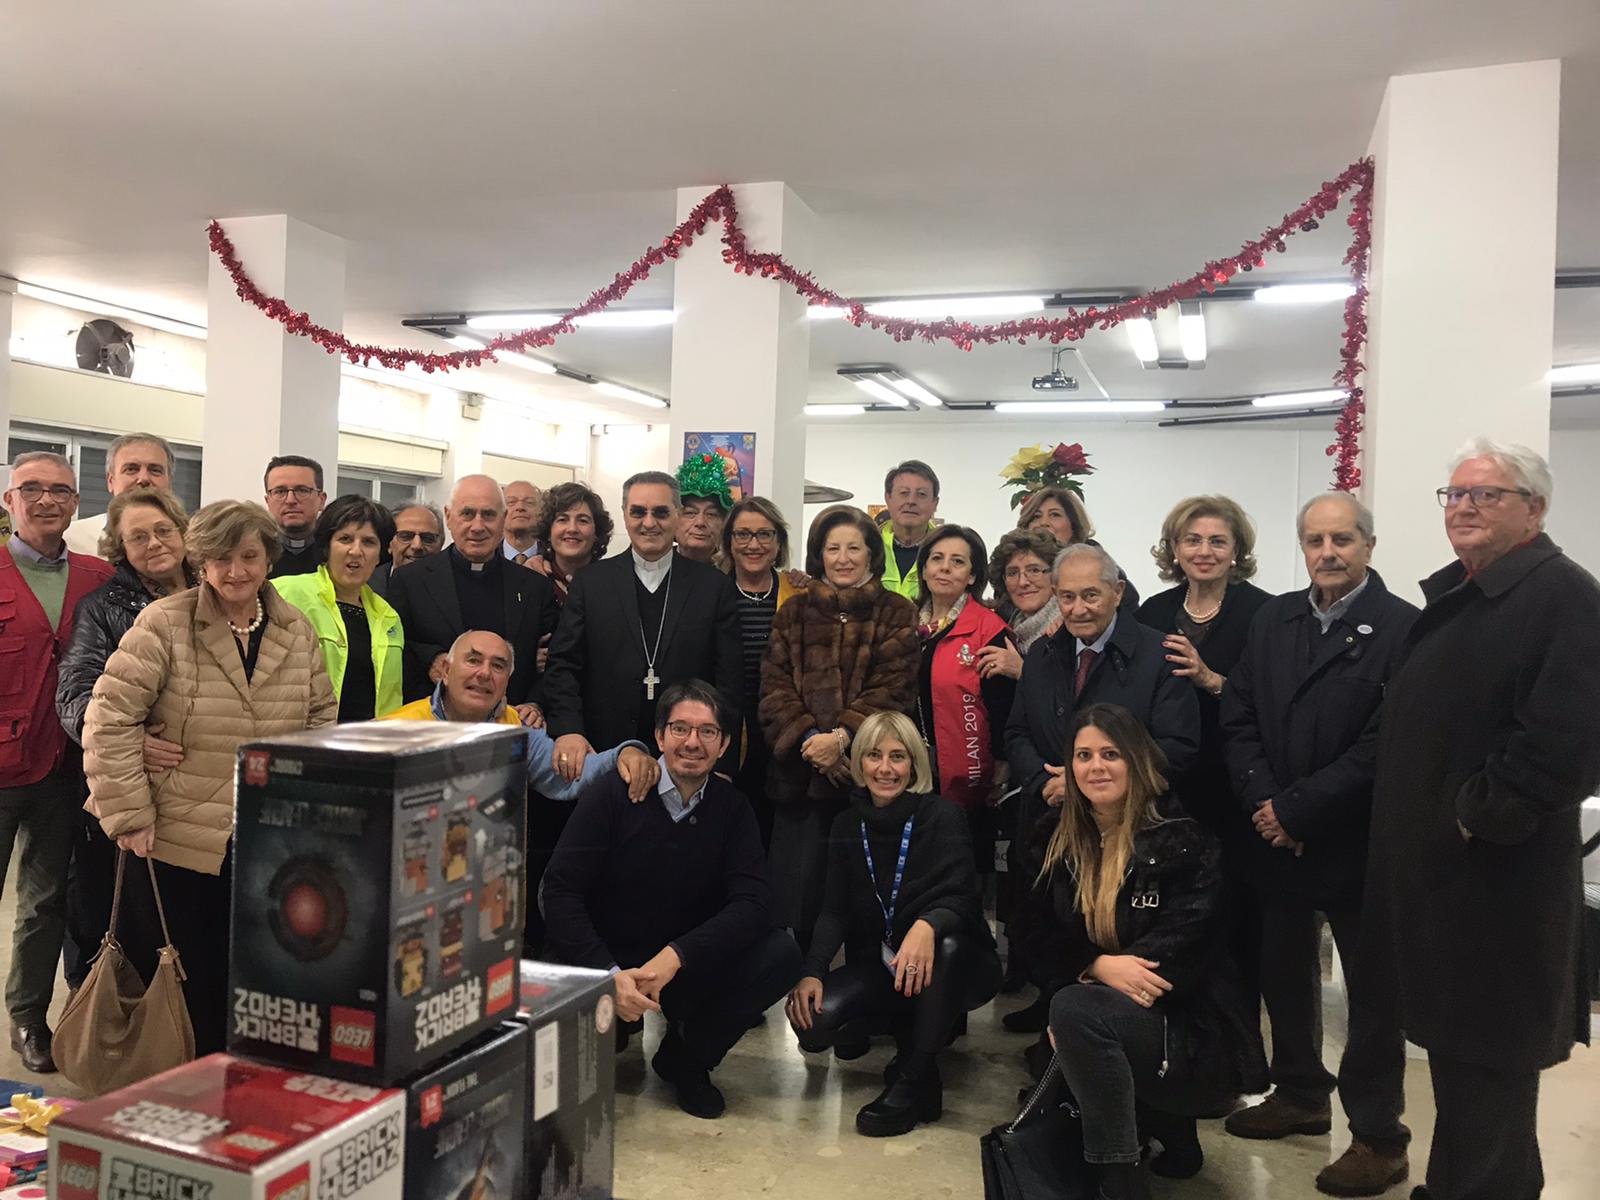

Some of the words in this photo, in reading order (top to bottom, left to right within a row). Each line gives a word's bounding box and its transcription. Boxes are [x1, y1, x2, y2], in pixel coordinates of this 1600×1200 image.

[962, 693, 978, 731] 2019
[966, 736, 981, 787] MILAN
[234, 988, 321, 1028] HEADZ
[416, 976, 481, 1028] HEADZ
[234, 1014, 297, 1047] BRICK
[334, 1025, 372, 1048] LEGO
[416, 1008, 464, 1052] BRICK
[341, 1111, 400, 1167] BRICK
[61, 1163, 97, 1190] LEGO
[318, 1137, 400, 1200] HEADZ
